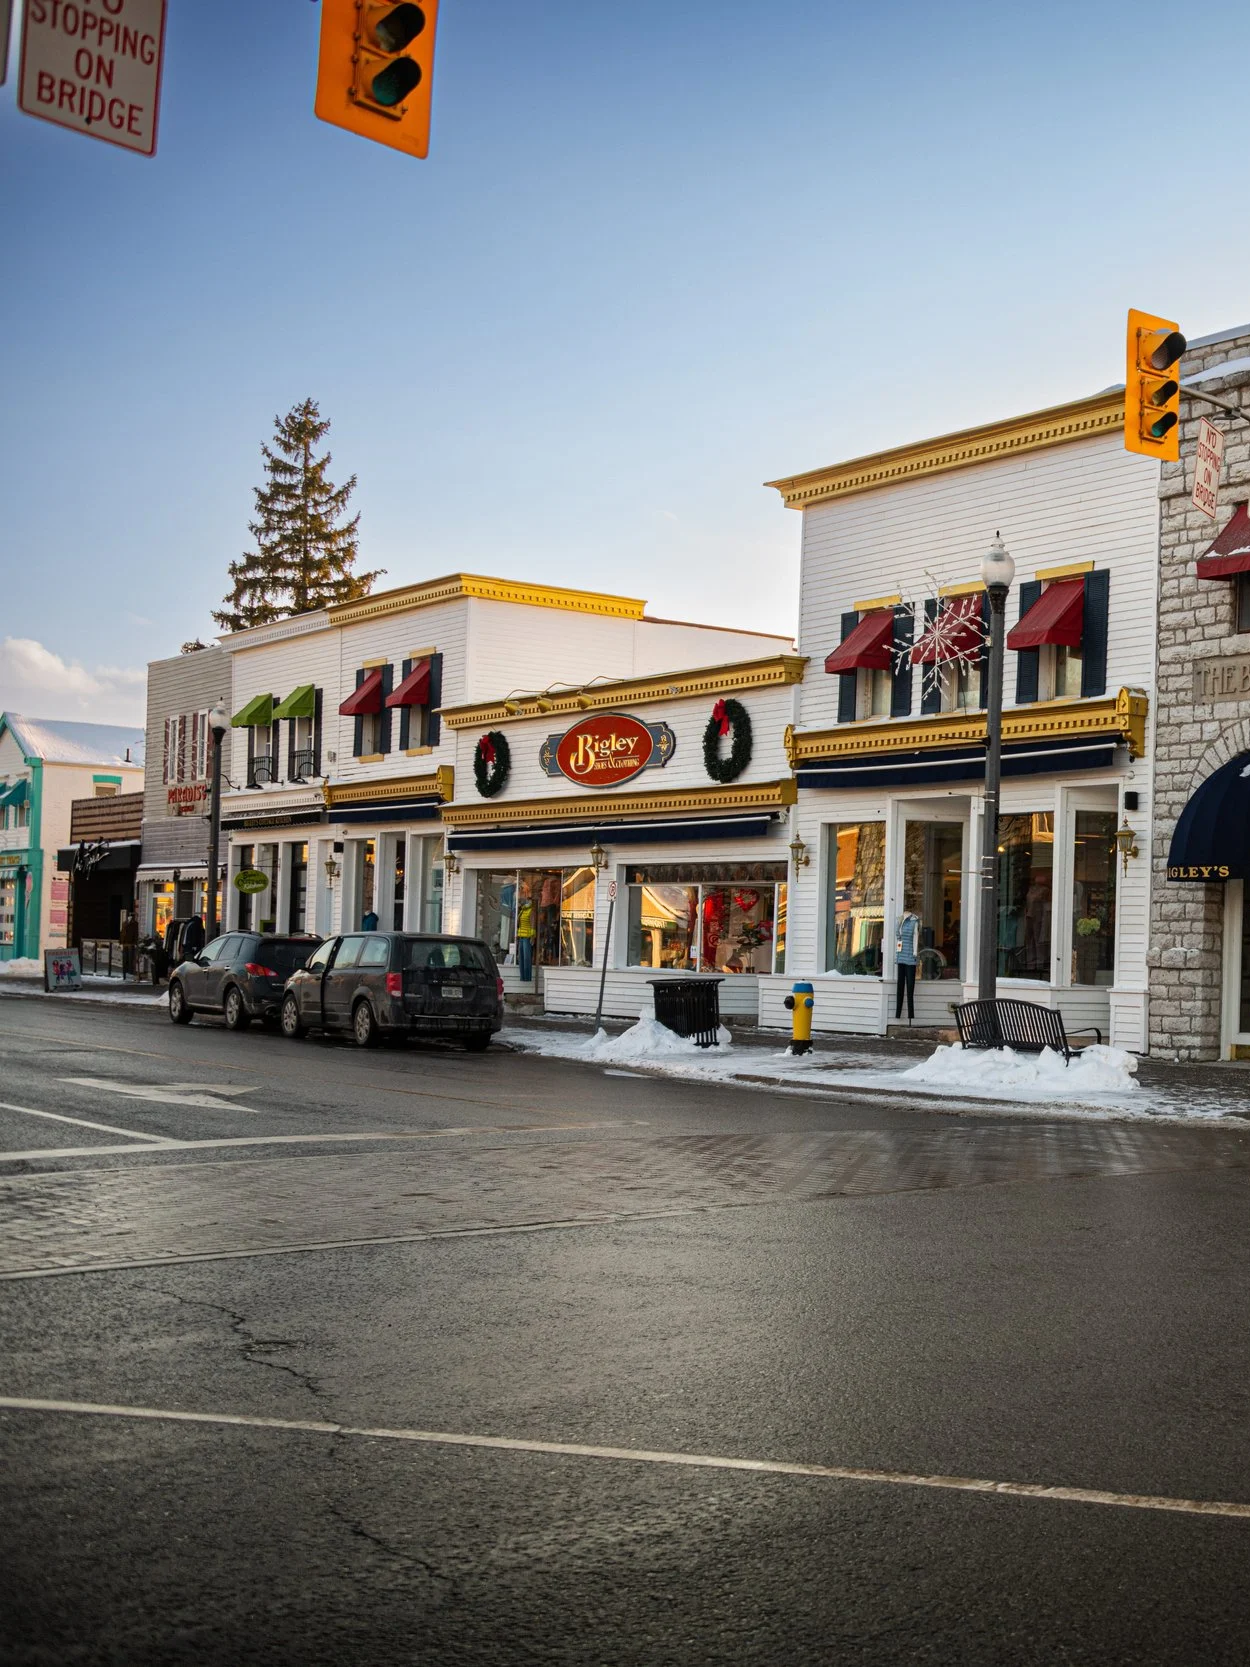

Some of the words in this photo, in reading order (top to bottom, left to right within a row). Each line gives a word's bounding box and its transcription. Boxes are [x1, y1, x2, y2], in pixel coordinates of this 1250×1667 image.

[31, 0, 156, 66] STOPPING
[74, 47, 114, 89] ON
[37, 70, 144, 136] BRIDGE
[1206, 427, 1217, 449] NO
[1198, 441, 1221, 473] STOPPING
[1203, 467, 1212, 486] ON
[1196, 481, 1215, 510] BRIDGE
[1196, 664, 1237, 697] THE
[569, 733, 639, 775] Bigley
[1168, 866, 1230, 878] IGLEY'S
